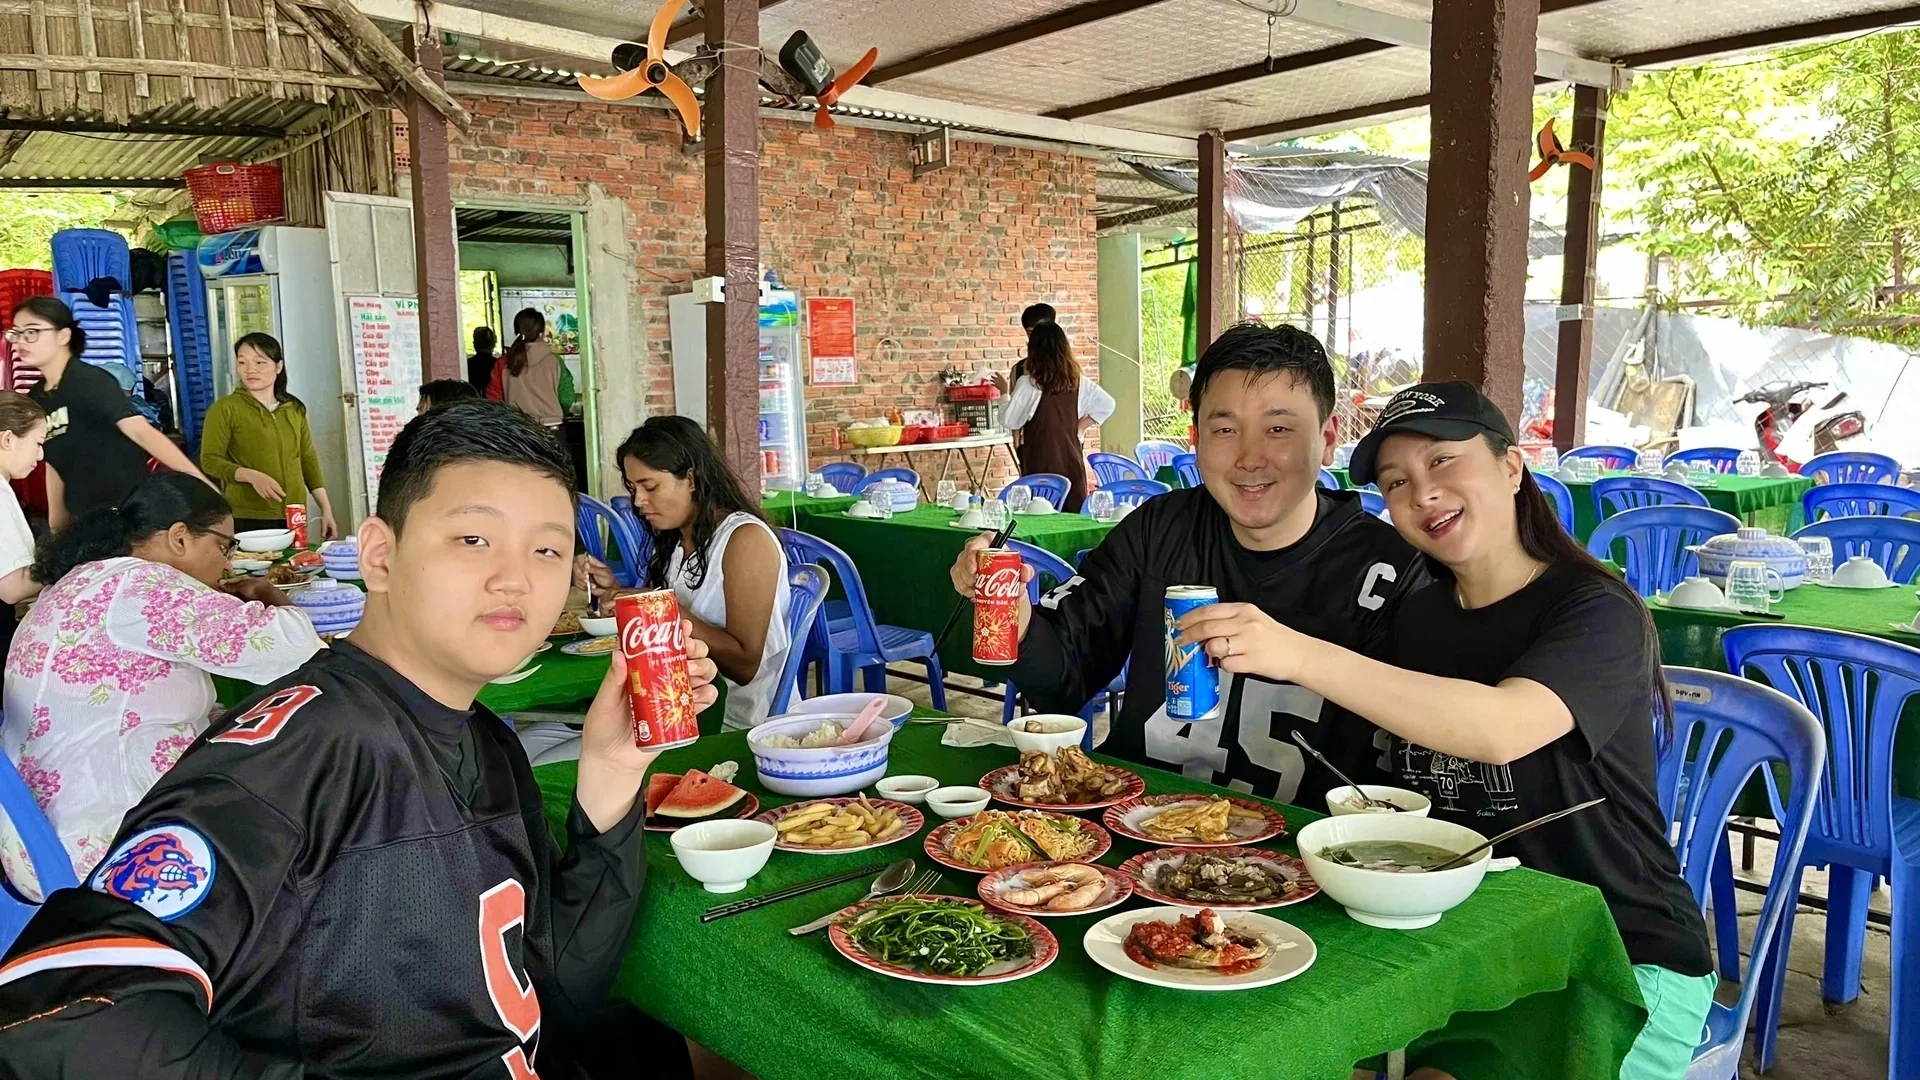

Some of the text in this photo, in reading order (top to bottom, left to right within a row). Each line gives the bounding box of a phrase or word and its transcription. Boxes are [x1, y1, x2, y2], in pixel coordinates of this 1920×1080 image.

[1357, 562, 1397, 611] C
[1167, 681, 1190, 695] Tiger
[1144, 668, 1325, 806] 45
[1440, 776, 1454, 790] 70
